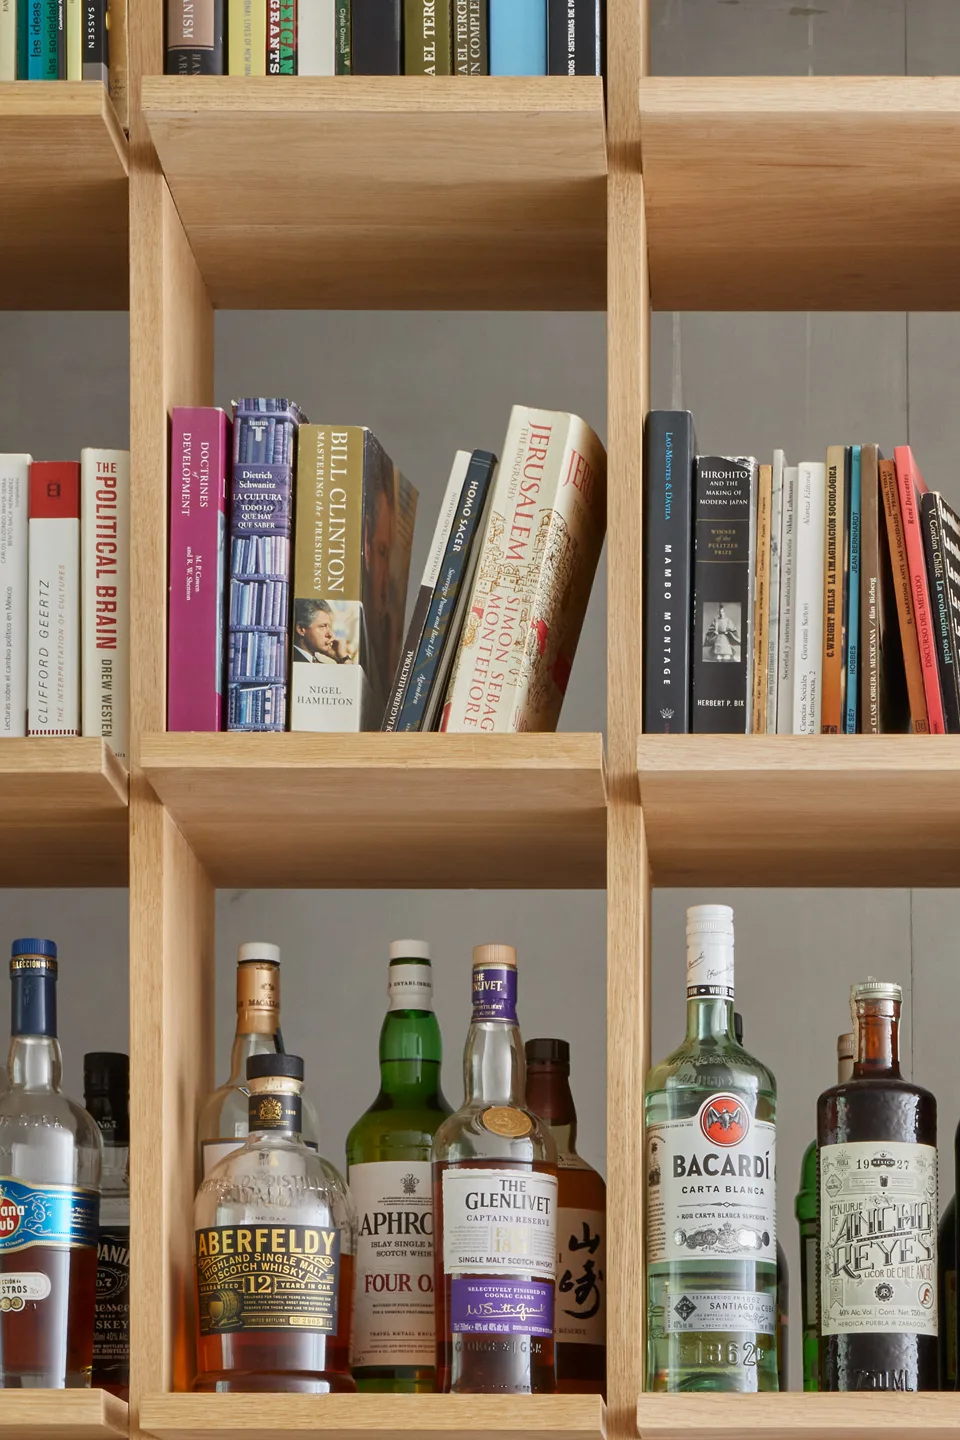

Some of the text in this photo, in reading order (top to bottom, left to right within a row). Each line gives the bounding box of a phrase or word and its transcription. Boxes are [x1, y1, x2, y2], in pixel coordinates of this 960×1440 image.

[30, 2, 42, 34] ideas
[424, 42, 435, 61] EL
[181, 432, 192, 516] DEVELOPMENT
[199, 442, 210, 507] DOCTRINES
[238, 480, 276, 489] Schwanitz
[241, 471, 272, 480] Dietrich
[505, 421, 552, 562] JERUSALEM
[314, 431, 324, 592] MASTERING PRESIDENCY
[328, 431, 348, 593] BILL CLINTON
[452, 480, 478, 552] HOMO SACER
[826, 465, 837, 614] MILLS IMAGINACIÓN SOCIOLÓGICA
[96, 476, 116, 737] POLITICAL BRAIN DREW WESTEN
[663, 545, 672, 685] MAMBO MONTAGE
[38, 579, 50, 723] CLIFFORD GEERTZ
[464, 594, 503, 728] MONTEFIORE
[921, 628, 932, 667] DISCURSO
[480, 596, 520, 732] SIMON SEBAG
[298, 696, 354, 706] HAMILTON
[310, 685, 342, 694] NIGEL
[672, 1151, 770, 1179] BACARDÍ
[682, 1186, 765, 1195] CARTA BLANCA
[834, 1202, 932, 1245] ANCHO
[198, 1228, 336, 1256] ABERFELDY
[832, 1232, 935, 1280] REYES
[204, 1253, 324, 1280] HIGHLAND SINGLE MALT
[218, 1262, 305, 1280] SCOTCH WHISKY
[508, 1258, 534, 1266] SCOTCH
[864, 1270, 884, 1278] LICOR
[246, 1276, 272, 1294] 12
[364, 1274, 412, 1292] FOUR
[709, 1302, 754, 1310] SANTIAGO
